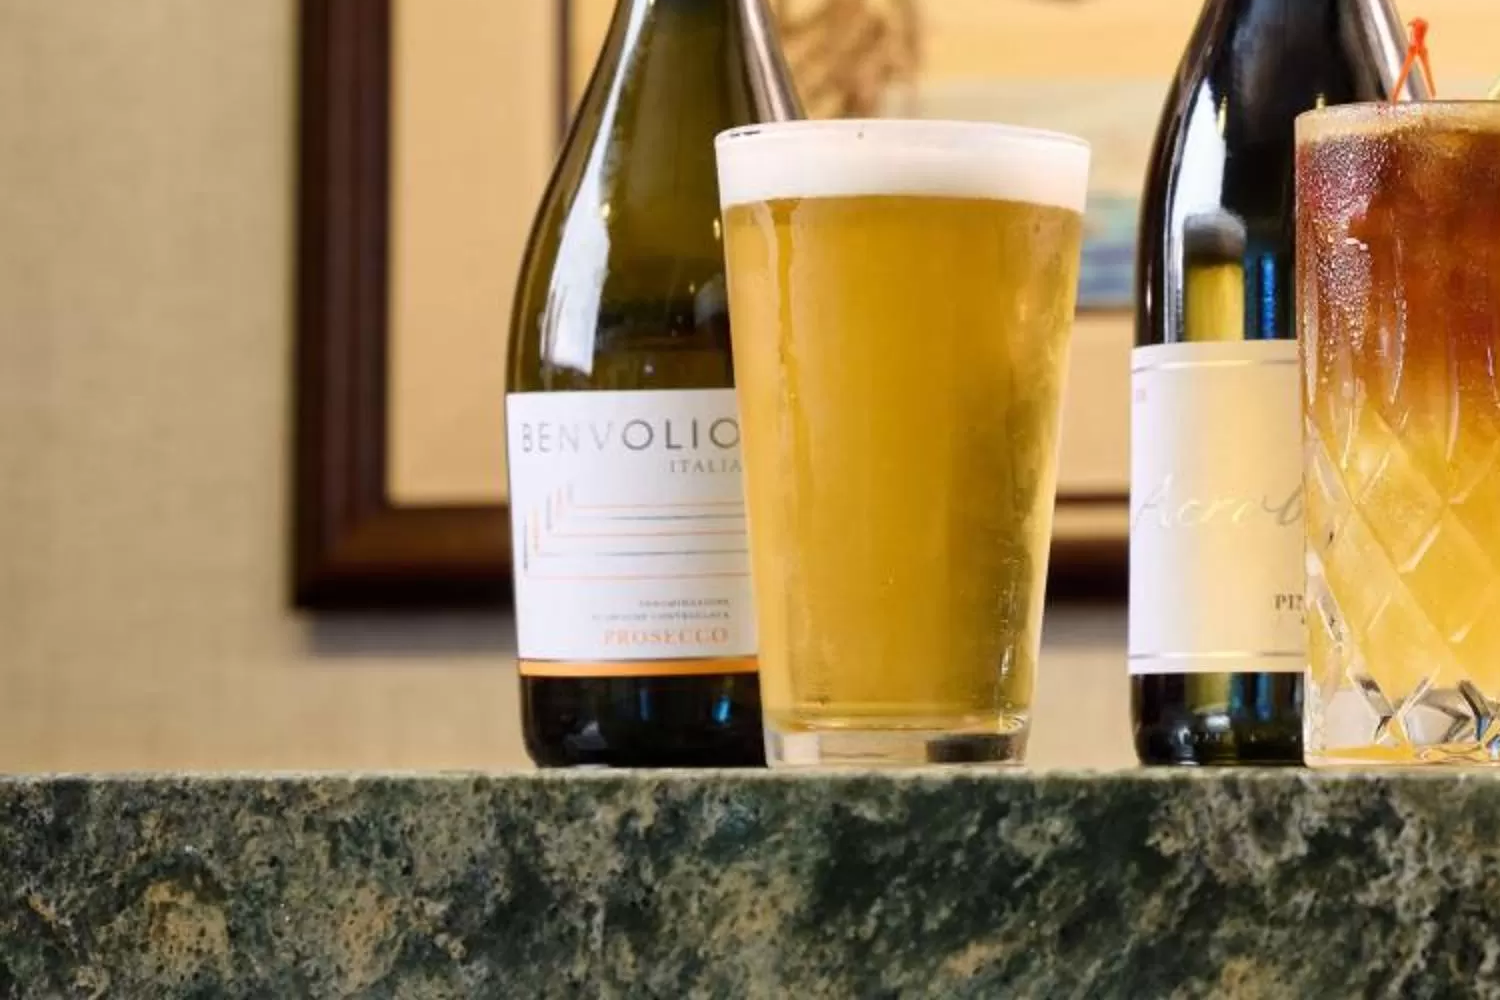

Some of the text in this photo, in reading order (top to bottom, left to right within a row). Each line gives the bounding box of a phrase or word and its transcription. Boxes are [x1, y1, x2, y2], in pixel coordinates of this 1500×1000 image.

[520, 416, 741, 453] BENVOLIO
[669, 458, 742, 473] ITALIA
[603, 627, 729, 645] PROSECCO
